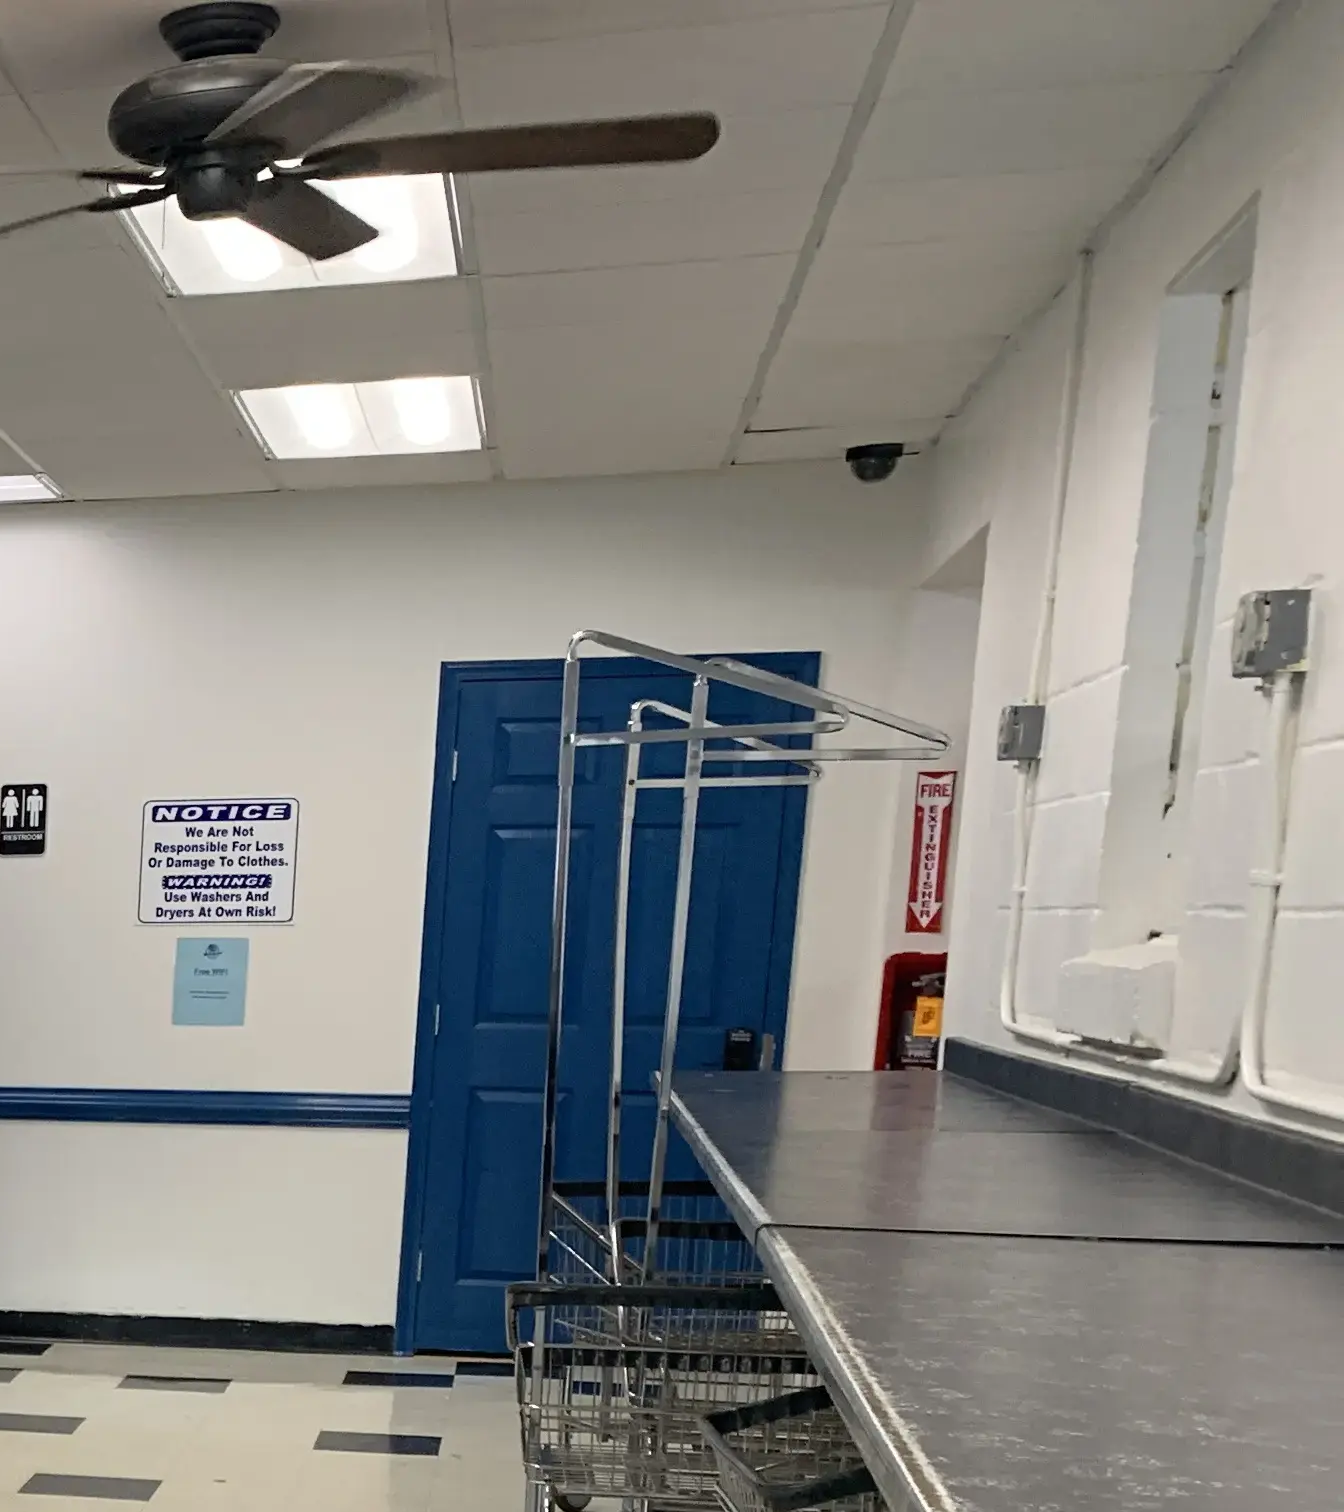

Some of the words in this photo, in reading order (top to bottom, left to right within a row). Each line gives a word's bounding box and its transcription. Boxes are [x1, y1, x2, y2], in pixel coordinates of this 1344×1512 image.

[920, 784, 952, 798] FIRE
[155, 805, 288, 821] NOTICE
[185, 827, 203, 837] We
[207, 827, 228, 837] Are
[232, 826, 254, 837] Not
[154, 841, 228, 855] Responsible
[232, 841, 252, 851] For
[256, 841, 284, 851] Loss
[148, 858, 162, 868] Or
[166, 857, 215, 870] Damage
[219, 856, 234, 867] To
[238, 856, 289, 867] Clothes.
[919, 805, 939, 918] EXTINGUISHER
[168, 877, 265, 887] WARNING!
[164, 892, 187, 902] Use
[191, 891, 241, 902] Washers
[245, 891, 269, 902] And
[156, 907, 194, 920] Dryers
[198, 907, 211, 917] At
[215, 906, 242, 917] Own
[246, 906, 276, 917] Risk!
